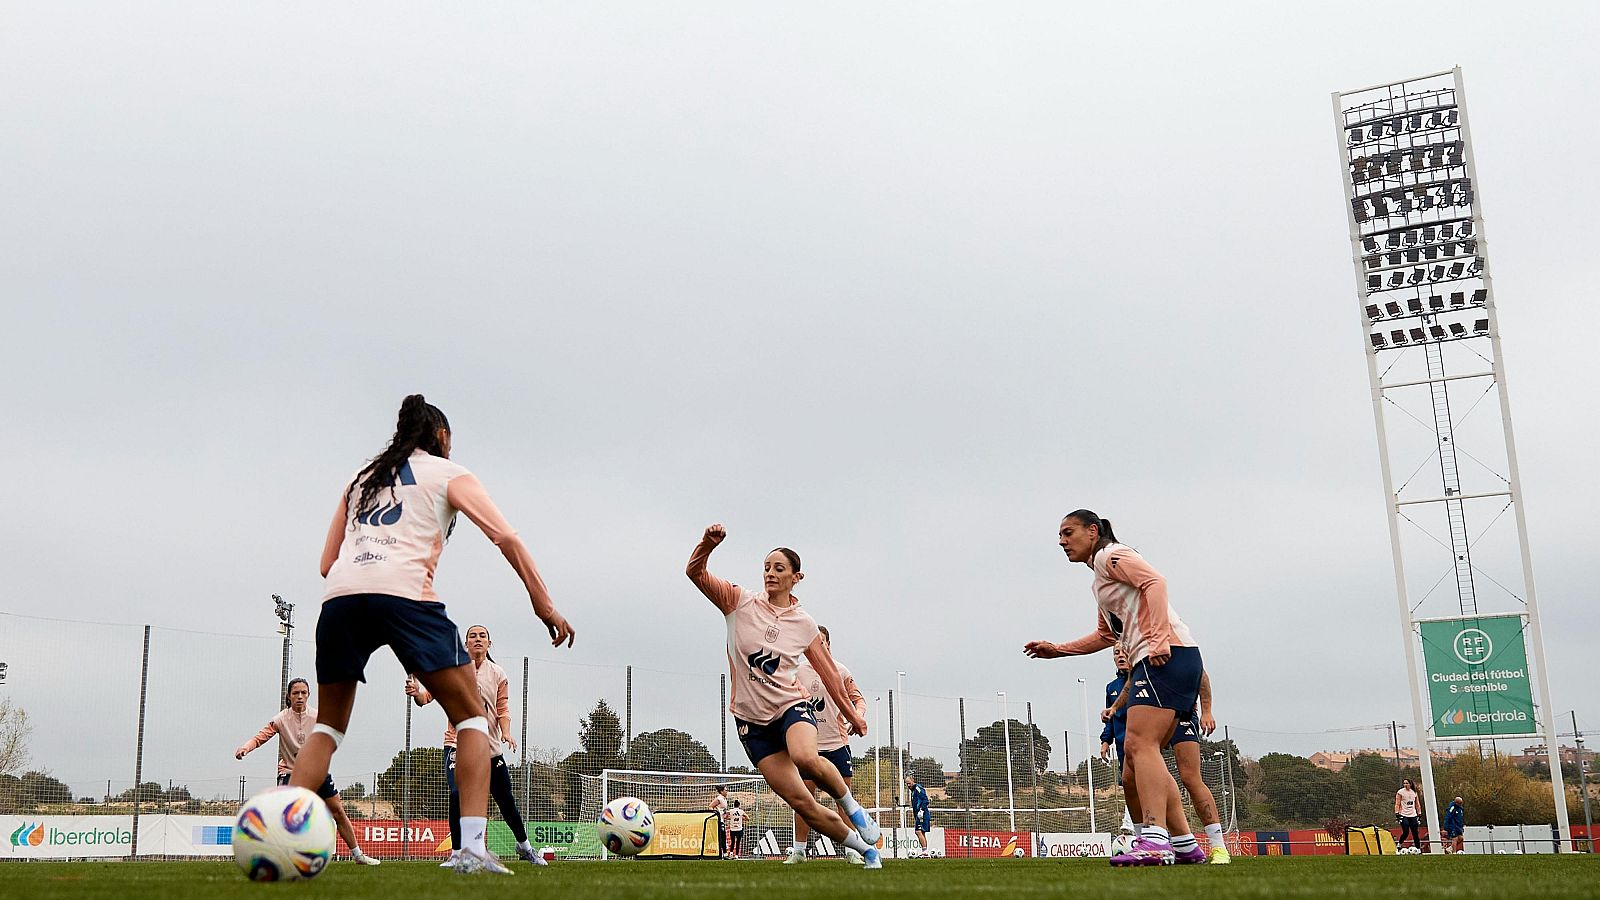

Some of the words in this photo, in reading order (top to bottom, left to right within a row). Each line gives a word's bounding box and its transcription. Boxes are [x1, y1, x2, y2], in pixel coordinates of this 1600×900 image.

[1431, 672, 1470, 683] Ciudad
[1471, 670, 1489, 680] del
[1490, 668, 1525, 679] fútbol
[1449, 683, 1508, 694] Sstenible
[1466, 710, 1527, 723] Iberdrola
[49, 827, 132, 846] Iberdrola
[364, 827, 435, 842] IBERIA
[659, 833, 703, 849] Halcó
[959, 835, 1002, 848] IBERIA
[885, 836, 923, 849] Iberdro
